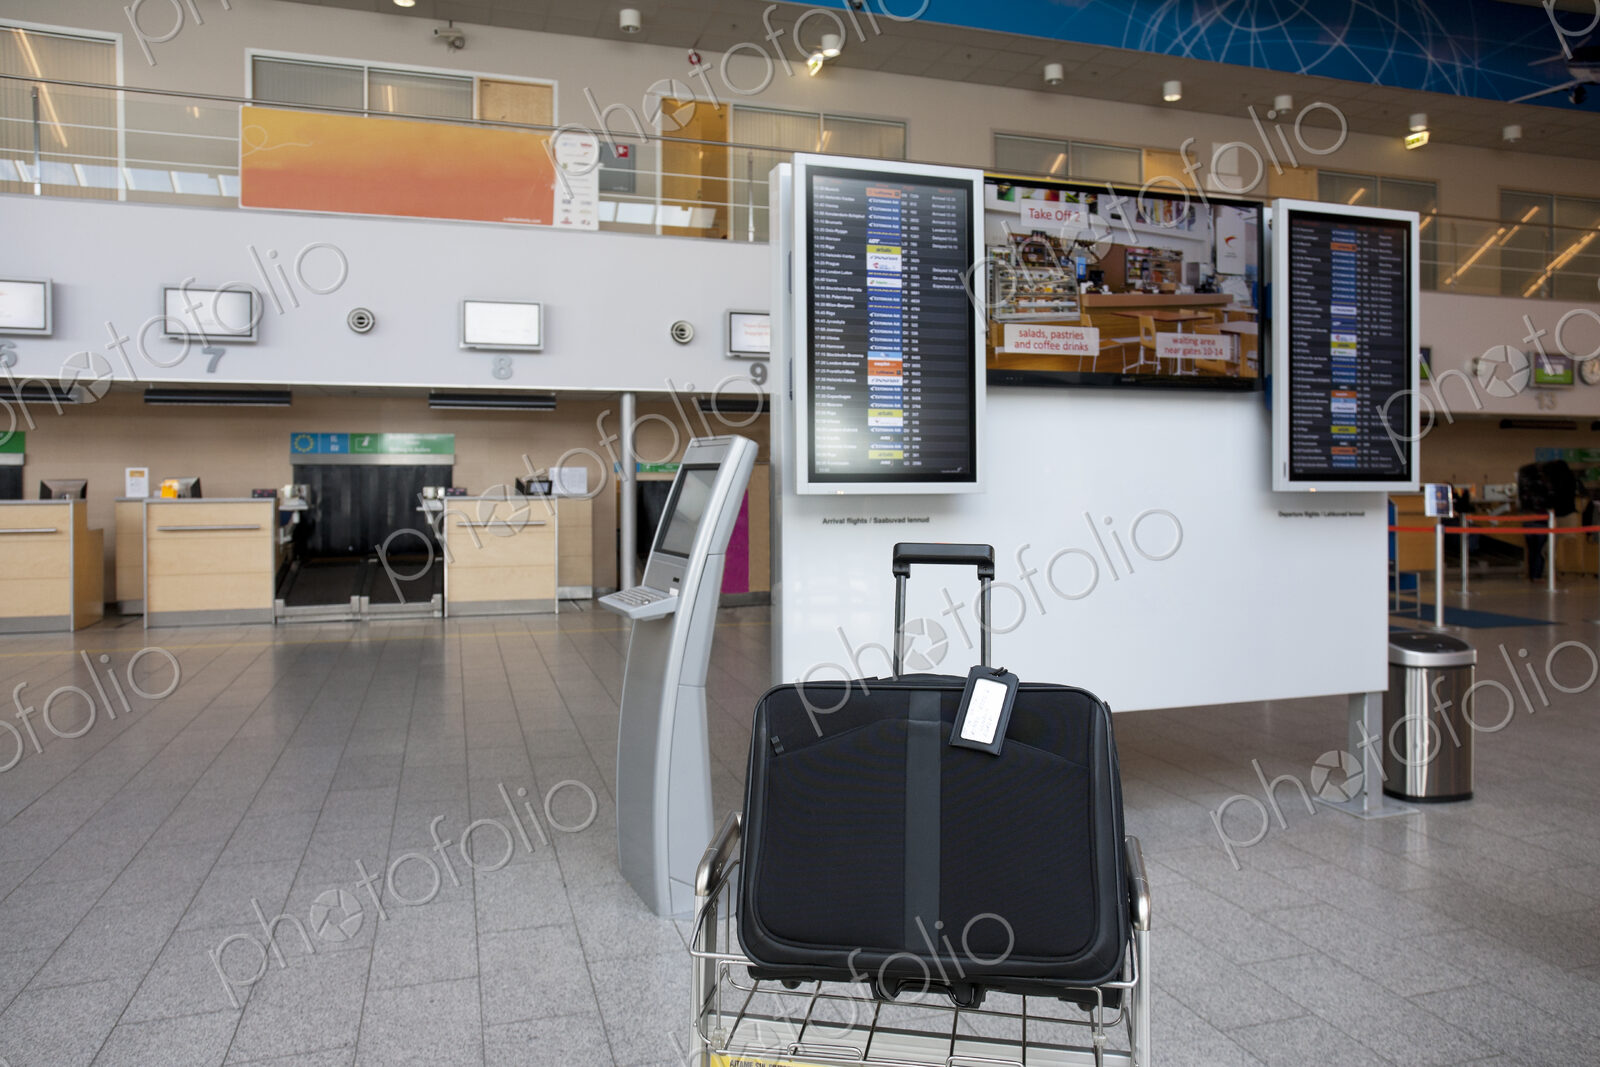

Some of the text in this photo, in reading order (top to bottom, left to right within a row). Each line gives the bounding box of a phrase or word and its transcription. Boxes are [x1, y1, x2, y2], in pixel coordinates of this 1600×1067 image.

[1028, 208, 1080, 222] Take Off 2
[1019, 329, 1084, 342] salads, pastries
[1172, 336, 1198, 348] waiting
[1014, 340, 1088, 352] and coffee drinks
[1182, 347, 1202, 357] gates
[201, 348, 226, 374] 7
[492, 354, 513, 380] 8
[750, 362, 768, 386] 9
[846, 516, 868, 525] flights
